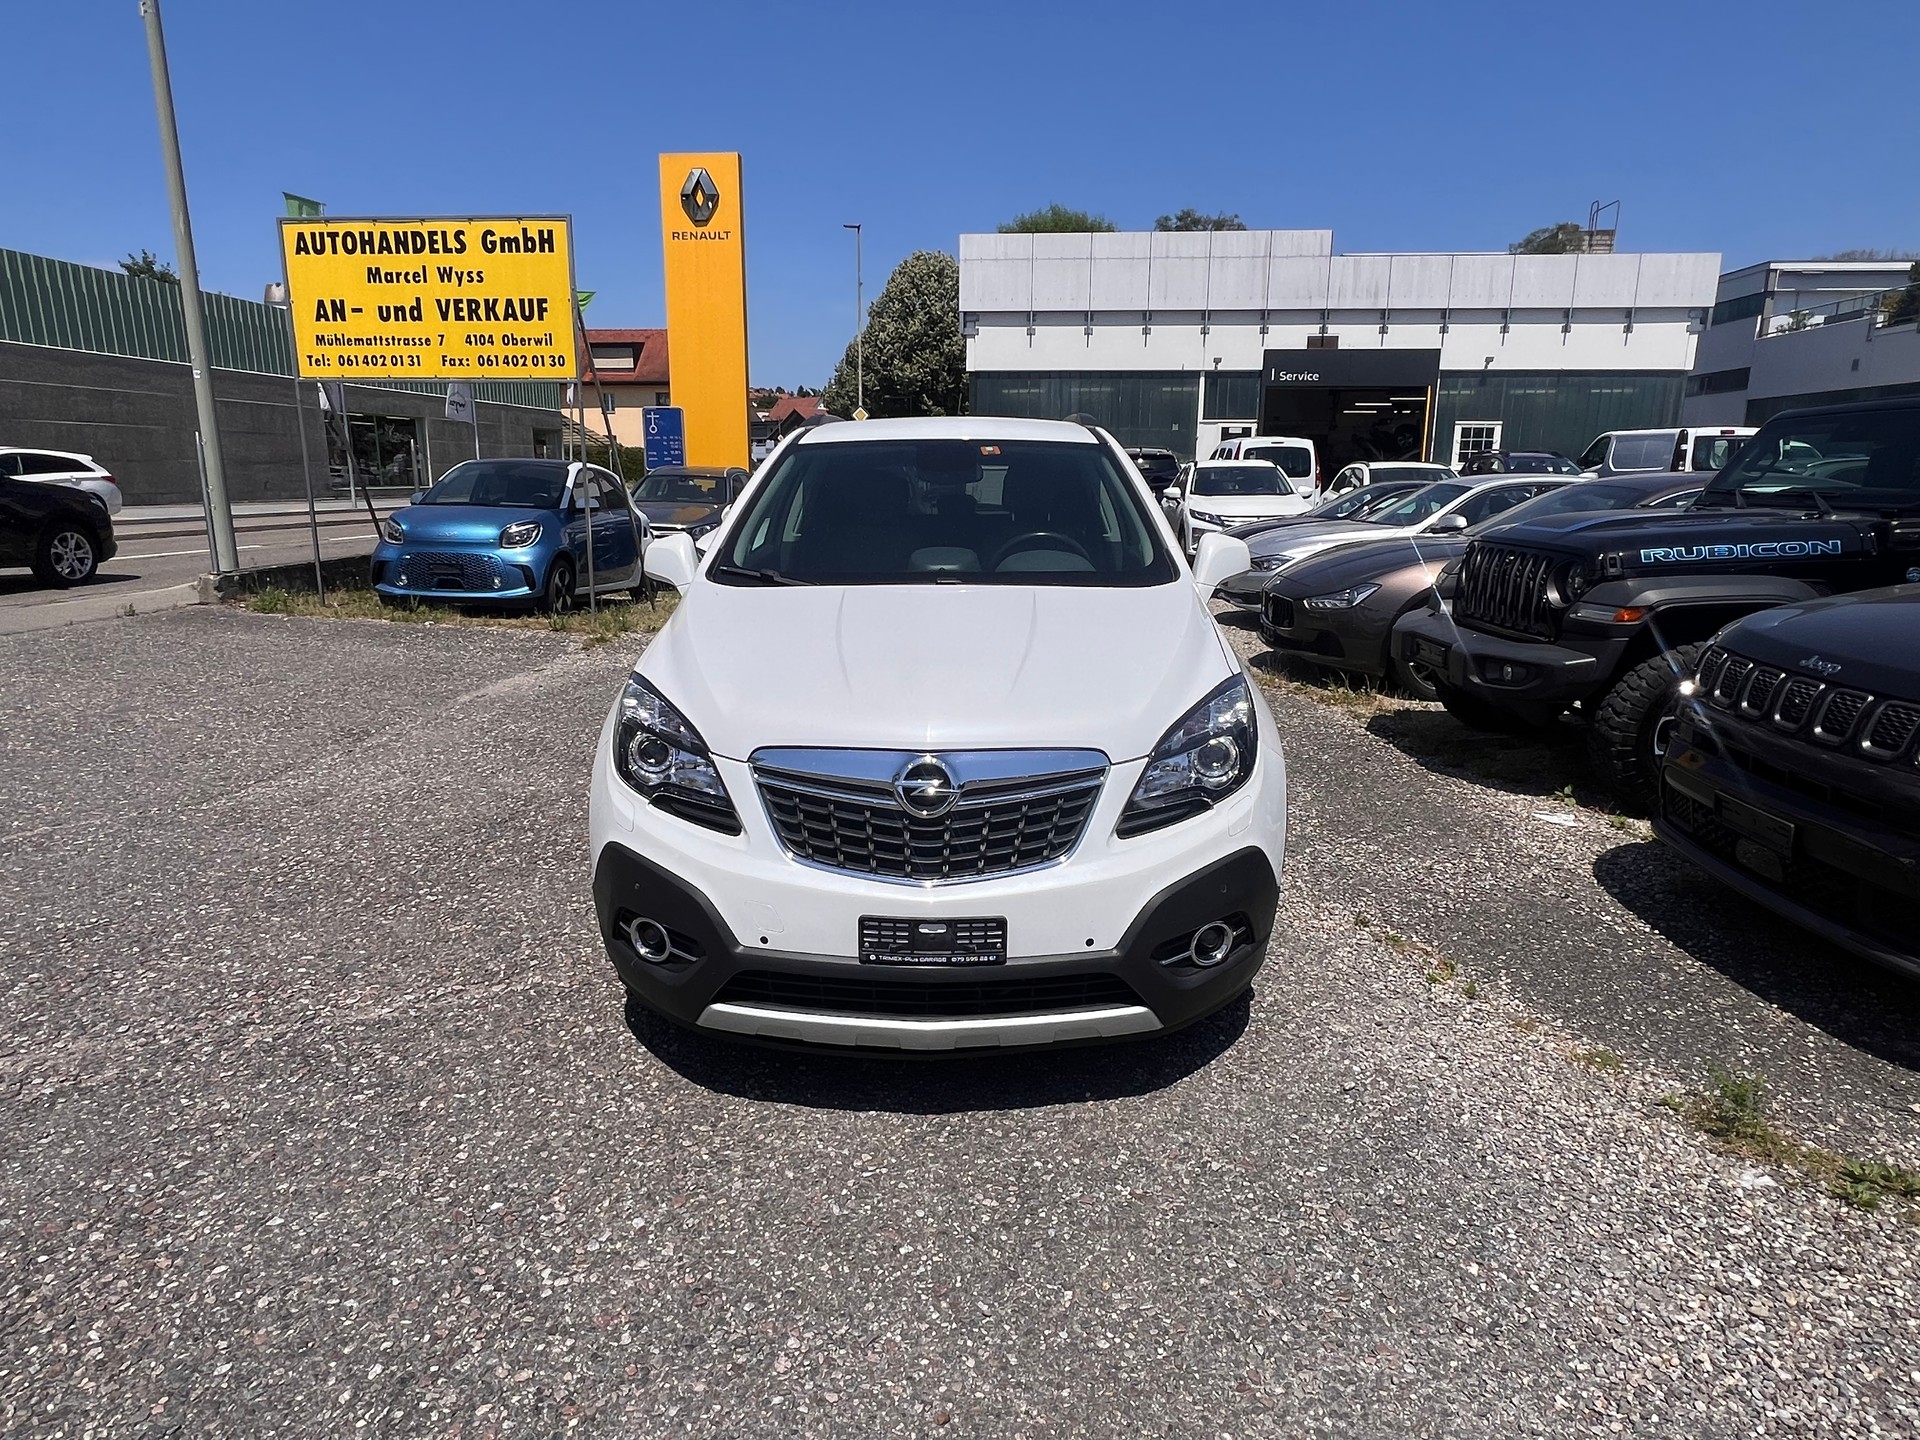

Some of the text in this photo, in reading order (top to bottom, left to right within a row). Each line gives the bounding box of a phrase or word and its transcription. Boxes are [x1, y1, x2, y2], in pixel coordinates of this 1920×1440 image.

[295, 227, 555, 256] AUTOHANDELS GmbH
[671, 230, 732, 241] RENAULT
[366, 264, 484, 287] Marcel Wyss
[377, 296, 423, 322] und
[434, 298, 549, 322] VERKAUF
[315, 333, 553, 347] Mühlemattstrasse 7 4104 Oberwil
[306, 353, 331, 367] Tel:
[441, 354, 470, 367] Fax:
[1279, 371, 1320, 381] Service
[1640, 539, 1842, 563] RUBICON
[1799, 655, 1842, 676] Jeep
